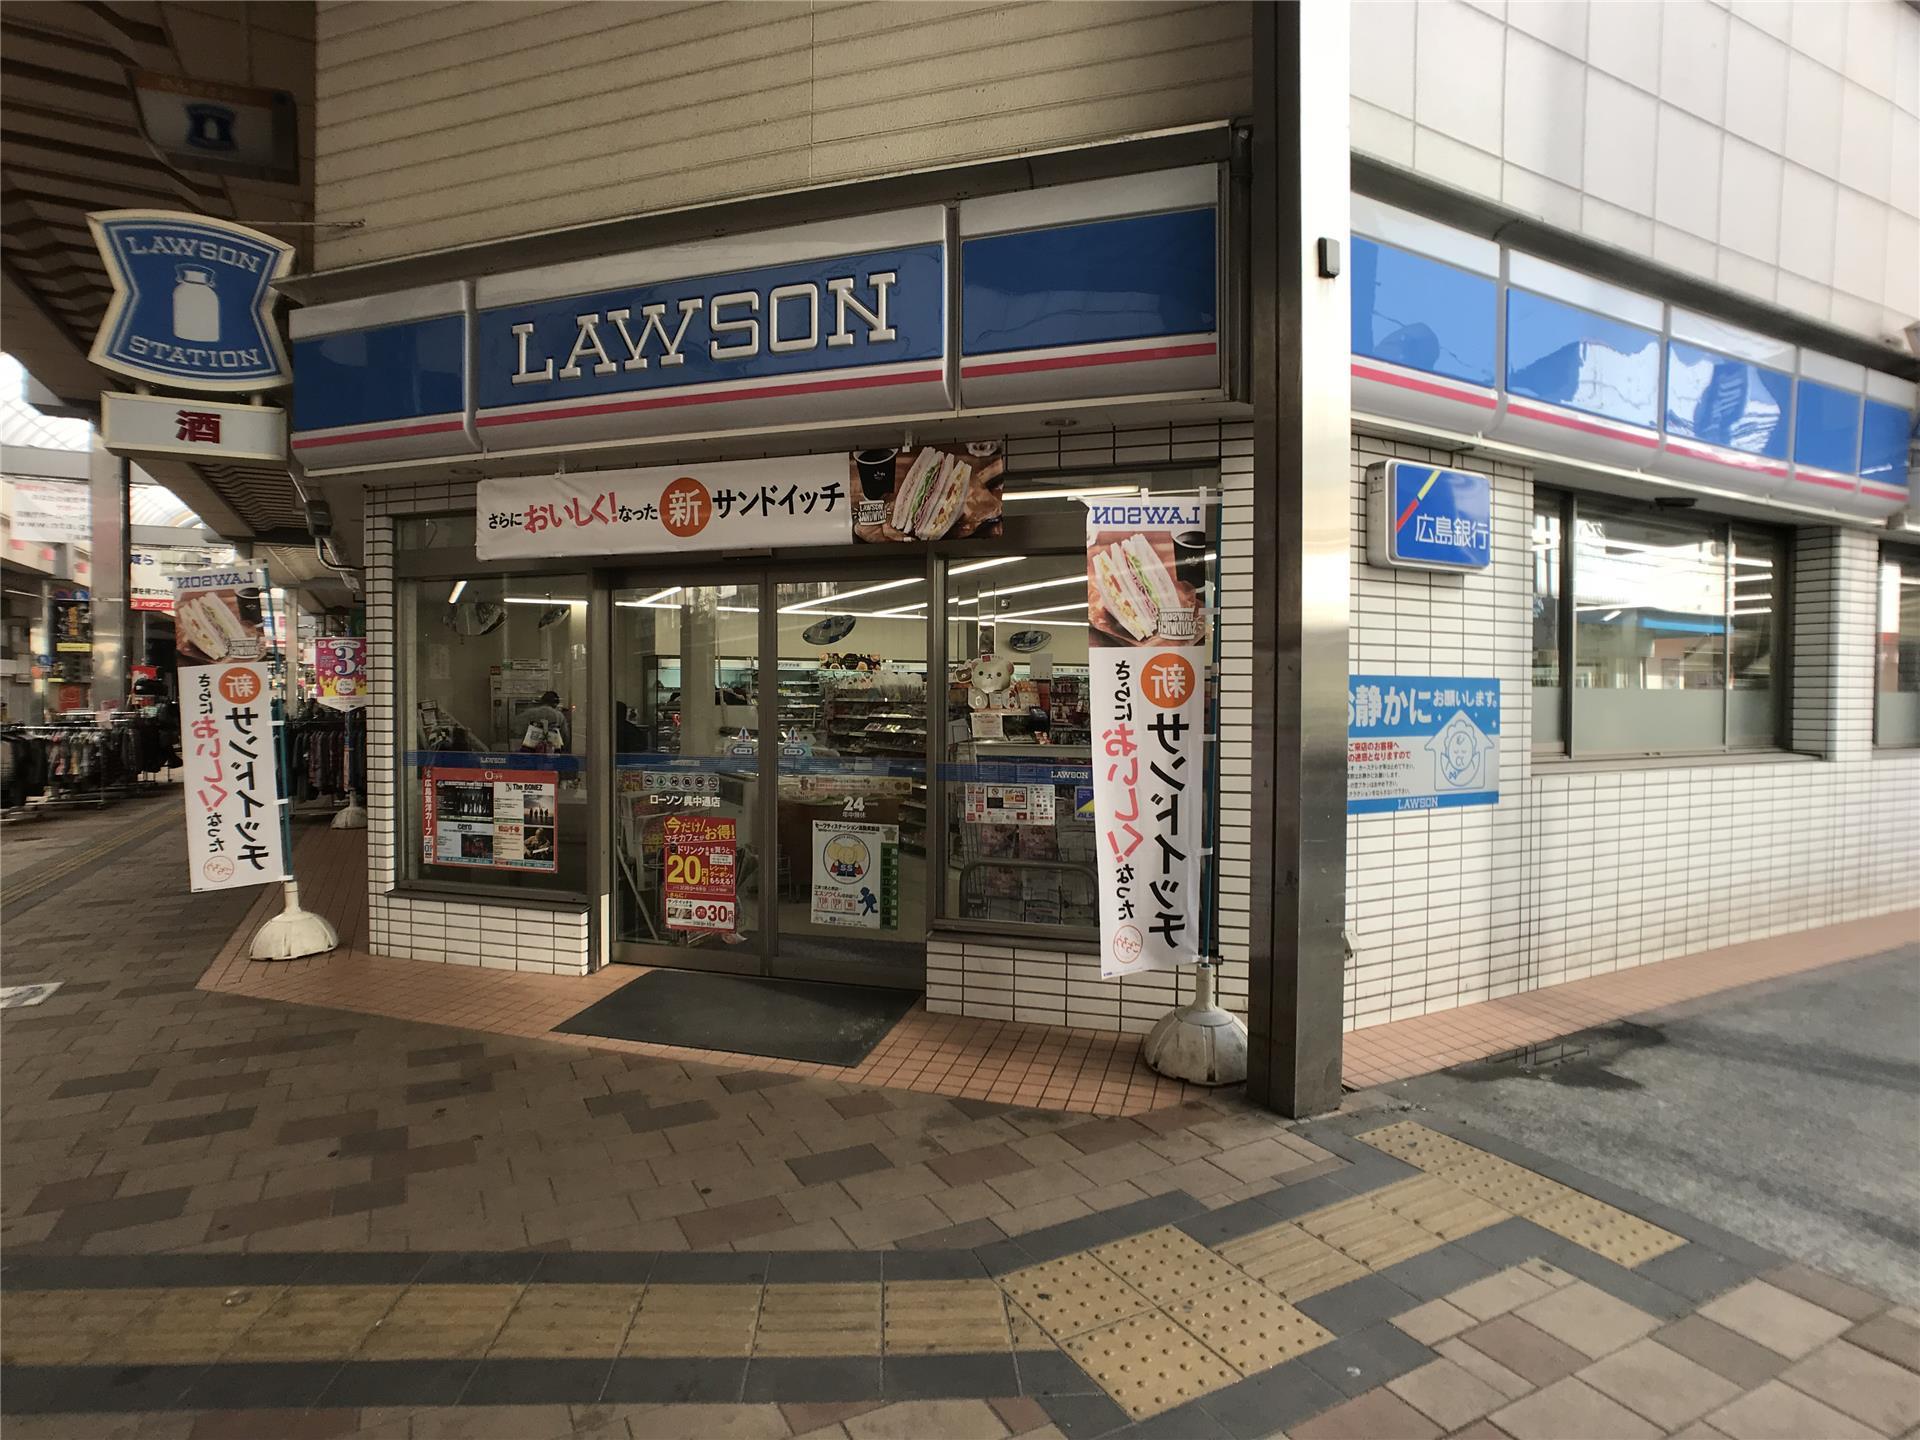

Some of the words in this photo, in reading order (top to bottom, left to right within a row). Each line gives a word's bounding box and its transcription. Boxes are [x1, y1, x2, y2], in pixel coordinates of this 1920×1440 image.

[126, 236, 260, 273] LAWSON
[511, 271, 897, 385] LAWSON
[129, 336, 262, 368] STATION
[175, 411, 221, 443] 酒
[668, 489, 702, 528] 新
[712, 481, 845, 519] サンドイッチ
[1415, 516, 1489, 550] 広島銀行
[1432, 689, 1498, 707] お願いします。
[1050, 770, 1089, 779] LAWSON
[843, 797, 865, 811] 24
[1398, 797, 1439, 810] LAWSON
[667, 855, 701, 885] 20
[707, 904, 727, 922] 30
